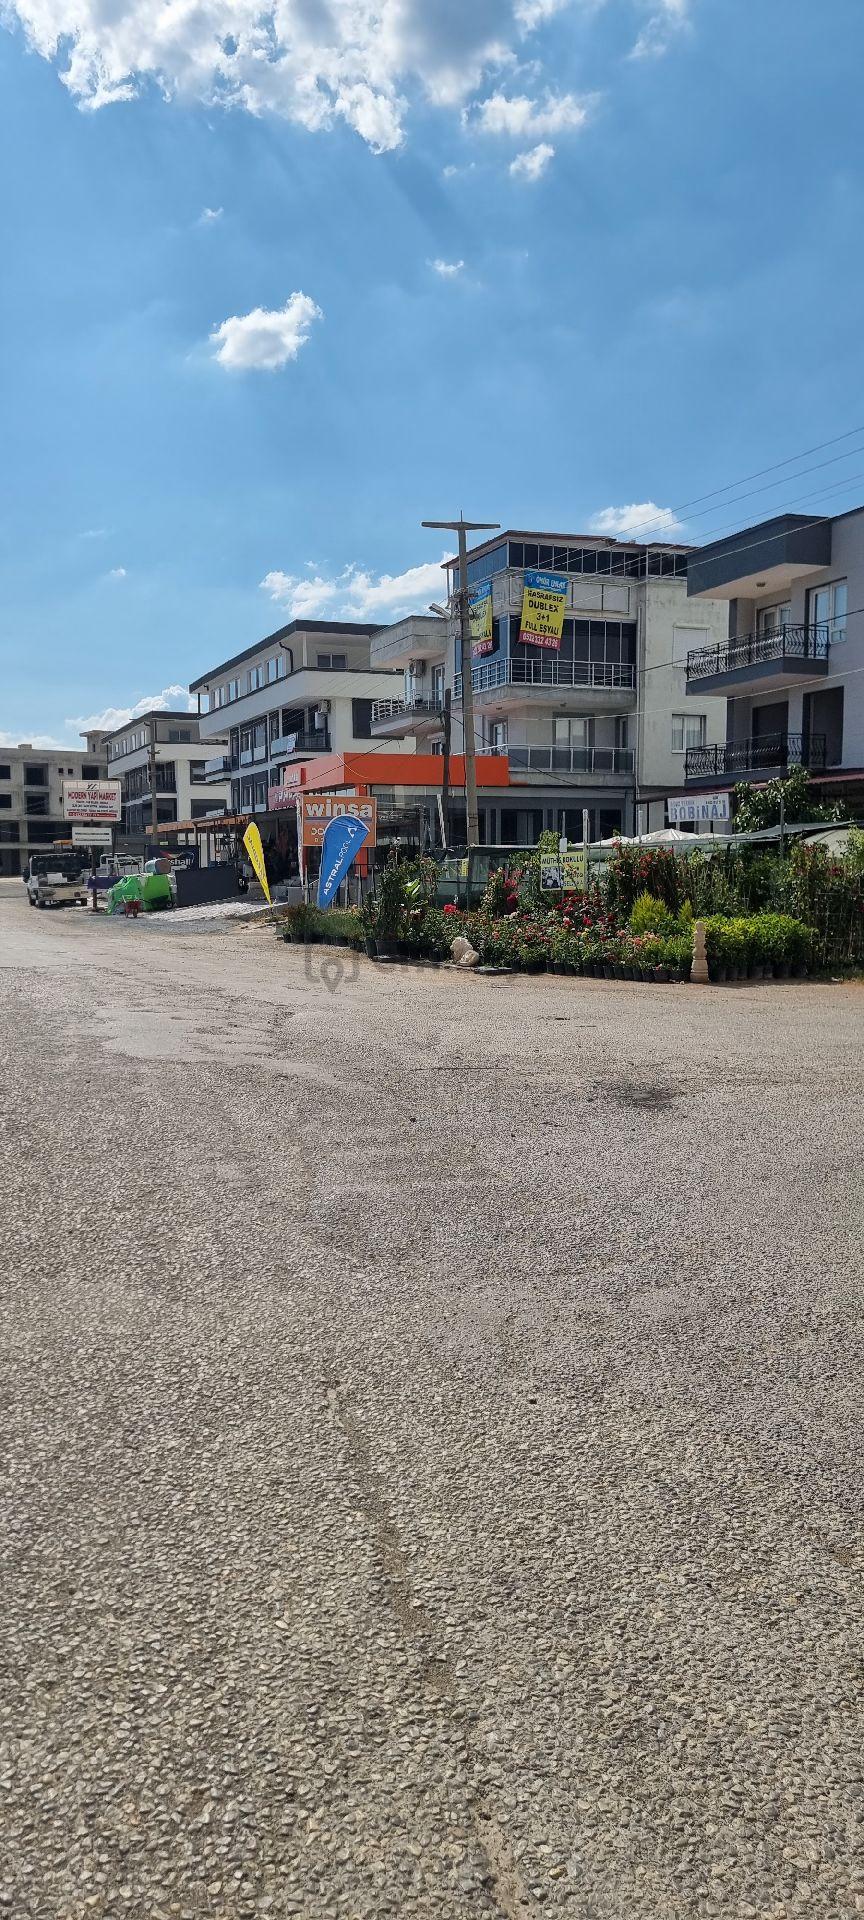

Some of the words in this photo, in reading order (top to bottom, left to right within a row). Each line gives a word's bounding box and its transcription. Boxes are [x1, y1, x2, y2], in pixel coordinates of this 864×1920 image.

[529, 600, 559, 612] DUBLEX
[536, 613, 550, 622] 3+1
[525, 621, 537, 631] FULL
[99, 792, 117, 801] MARKET
[305, 799, 373, 817] winsa
